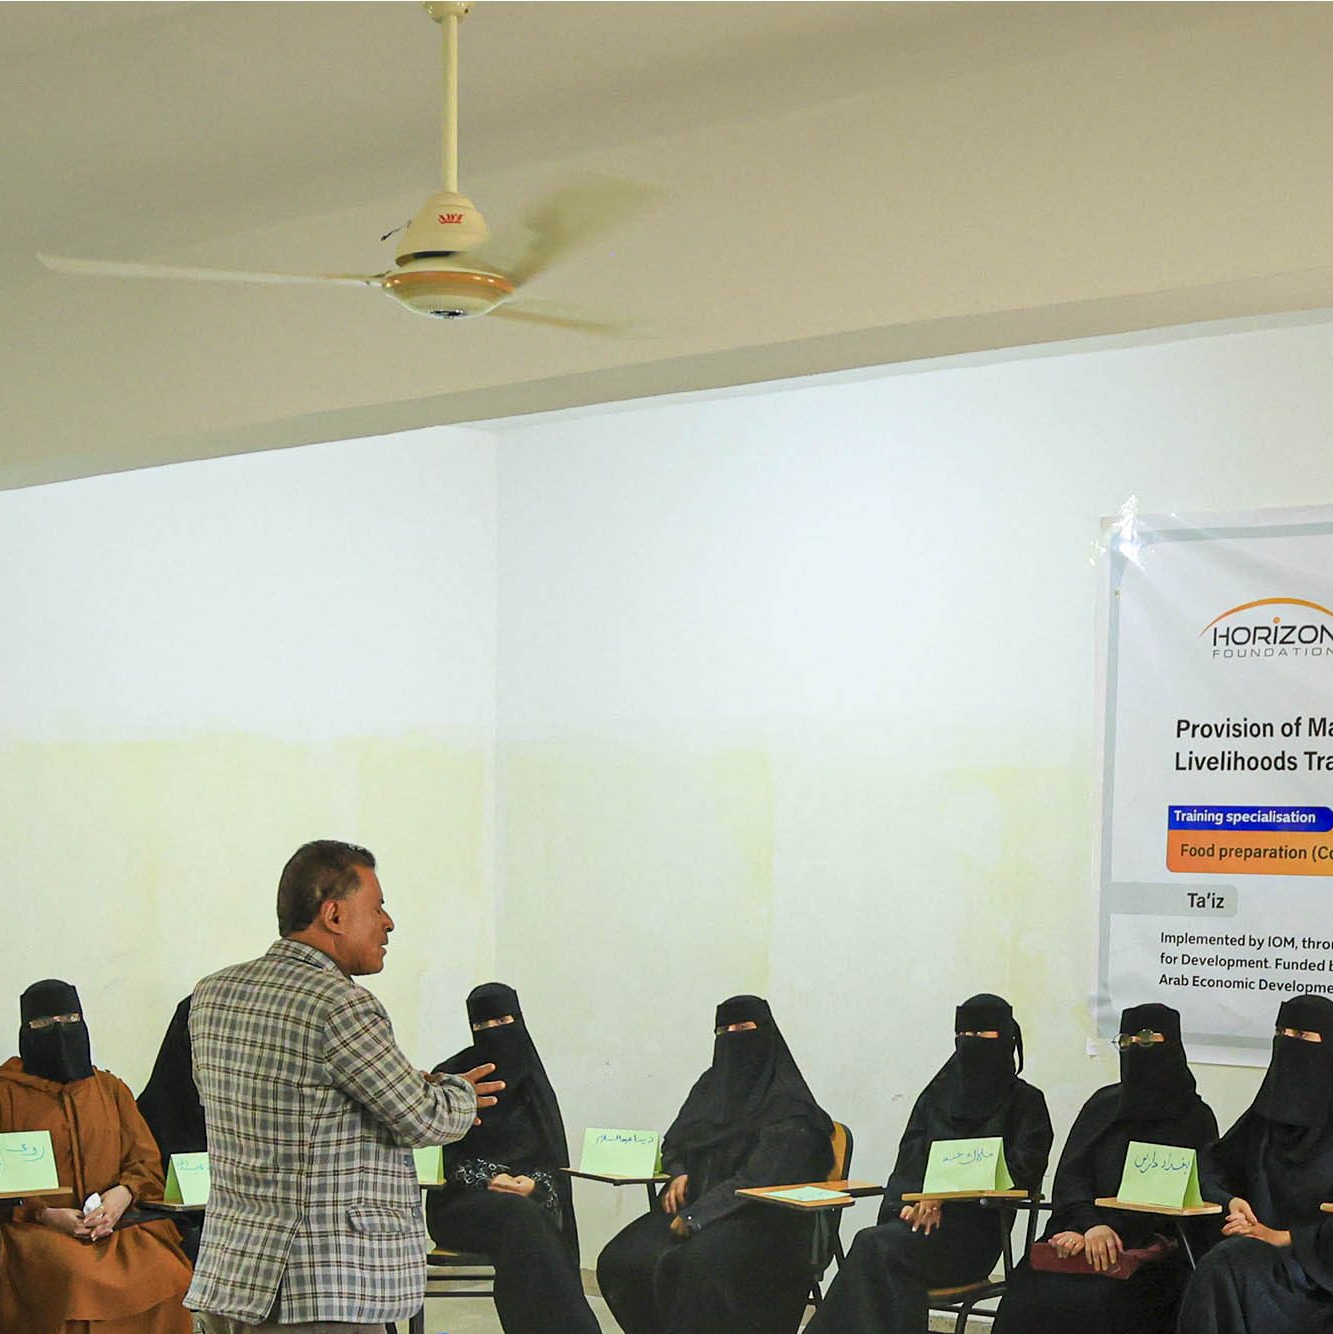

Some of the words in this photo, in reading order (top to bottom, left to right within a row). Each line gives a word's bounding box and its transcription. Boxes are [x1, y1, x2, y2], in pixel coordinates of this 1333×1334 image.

[1176, 717, 1275, 739] Provision
[1280, 716, 1302, 738] of
[1174, 750, 1298, 772] Livelihoods
[1174, 809, 1224, 825] Training
[1226, 809, 1317, 825] specialisation
[1180, 843, 1216, 858] Food
[1218, 844, 1308, 861] preparation
[1160, 931, 1246, 949] Implemented
[1248, 934, 1265, 952] by
[1267, 935, 1298, 951] IOM,
[1160, 952, 1179, 966] for
[1181, 953, 1272, 972] Development.
[1274, 957, 1326, 973] Funded
[1158, 973, 1189, 988] Arab
[1192, 976, 1257, 991] Economic
